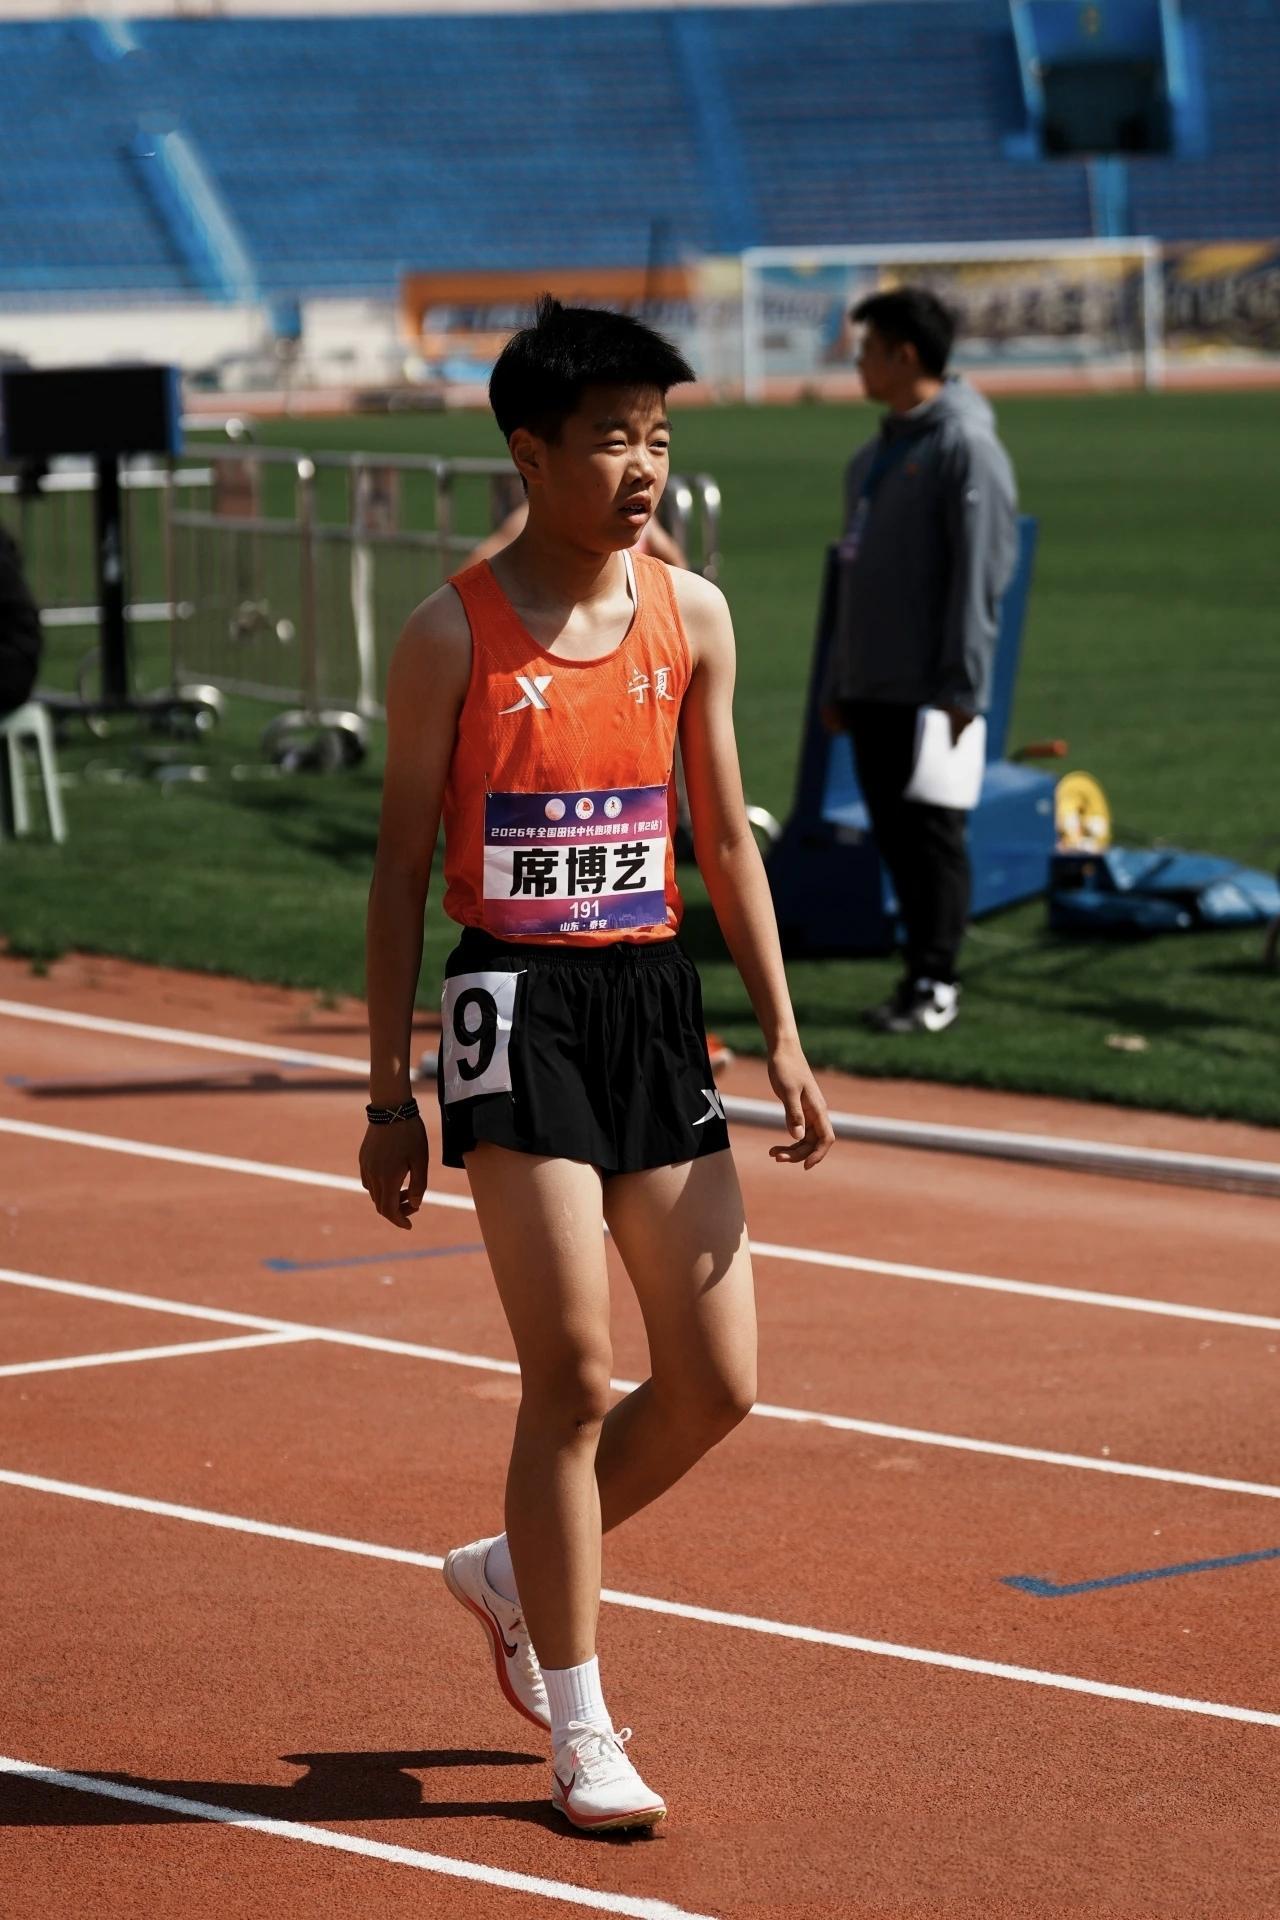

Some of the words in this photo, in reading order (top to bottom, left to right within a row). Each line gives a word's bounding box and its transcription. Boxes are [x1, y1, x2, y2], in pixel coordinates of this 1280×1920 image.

[627, 666, 675, 704] 宁夏
[510, 842, 650, 897] 席博艺
[569, 900, 599, 918] 191
[453, 988, 498, 1081] 9
